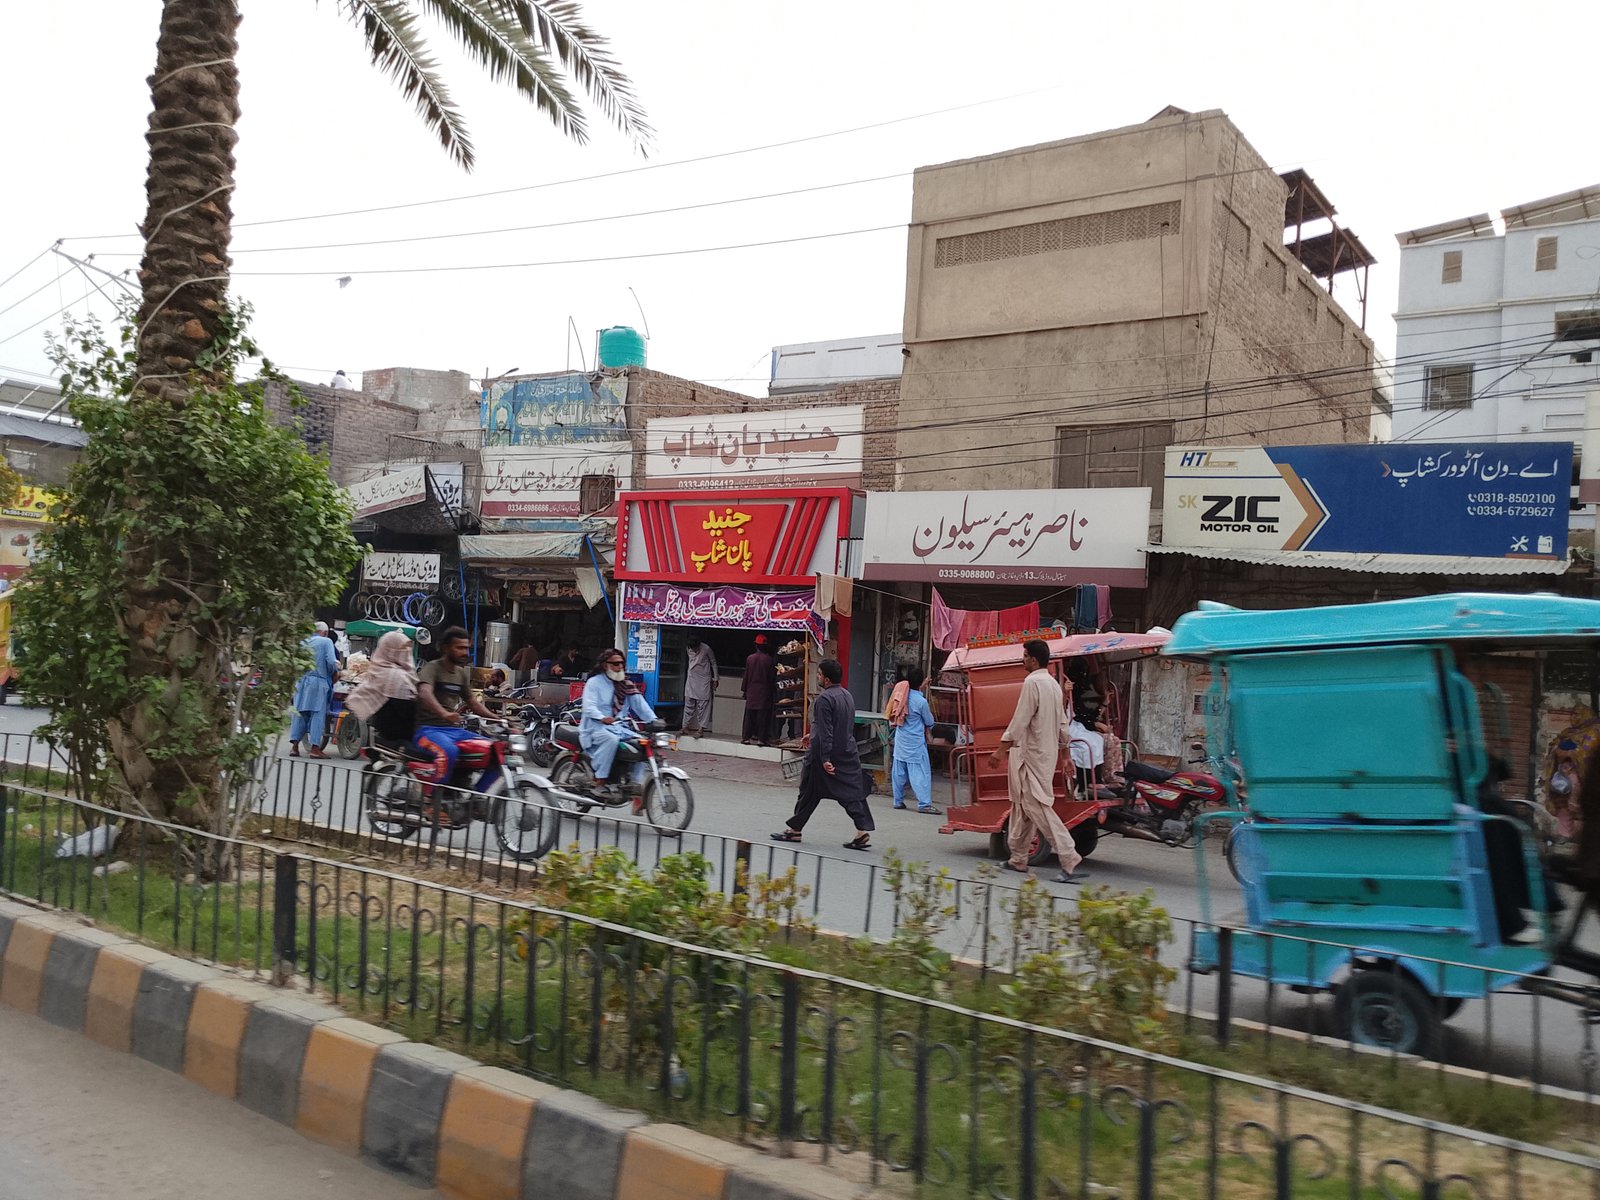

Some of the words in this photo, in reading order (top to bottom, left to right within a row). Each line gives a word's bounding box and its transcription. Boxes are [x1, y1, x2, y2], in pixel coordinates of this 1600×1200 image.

[663, 422, 718, 471] شاپ
[720, 423, 762, 470] پان
[765, 423, 840, 463] جنید
[1178, 495, 1198, 509] SK
[1201, 495, 1280, 523] ZIC
[1477, 492, 1556, 504] 0318-8502100
[1477, 506, 1556, 517] 0334-6729627
[702, 507, 753, 537] جنید
[912, 494, 992, 558] سیلون
[1017, 509, 1089, 559] ناصر
[1200, 523, 1252, 533] MOTOR
[1256, 524, 1279, 533] OIL
[690, 538, 727, 573] شاپ
[726, 539, 753, 573] پان
[938, 568, 996, 579] 0335-9088800
[1024, 571, 1034, 580] 13
[655, 589, 682, 619] بوتل
[681, 589, 704, 620] کی
[754, 593, 777, 624] کی
[770, 598, 815, 628] نید
